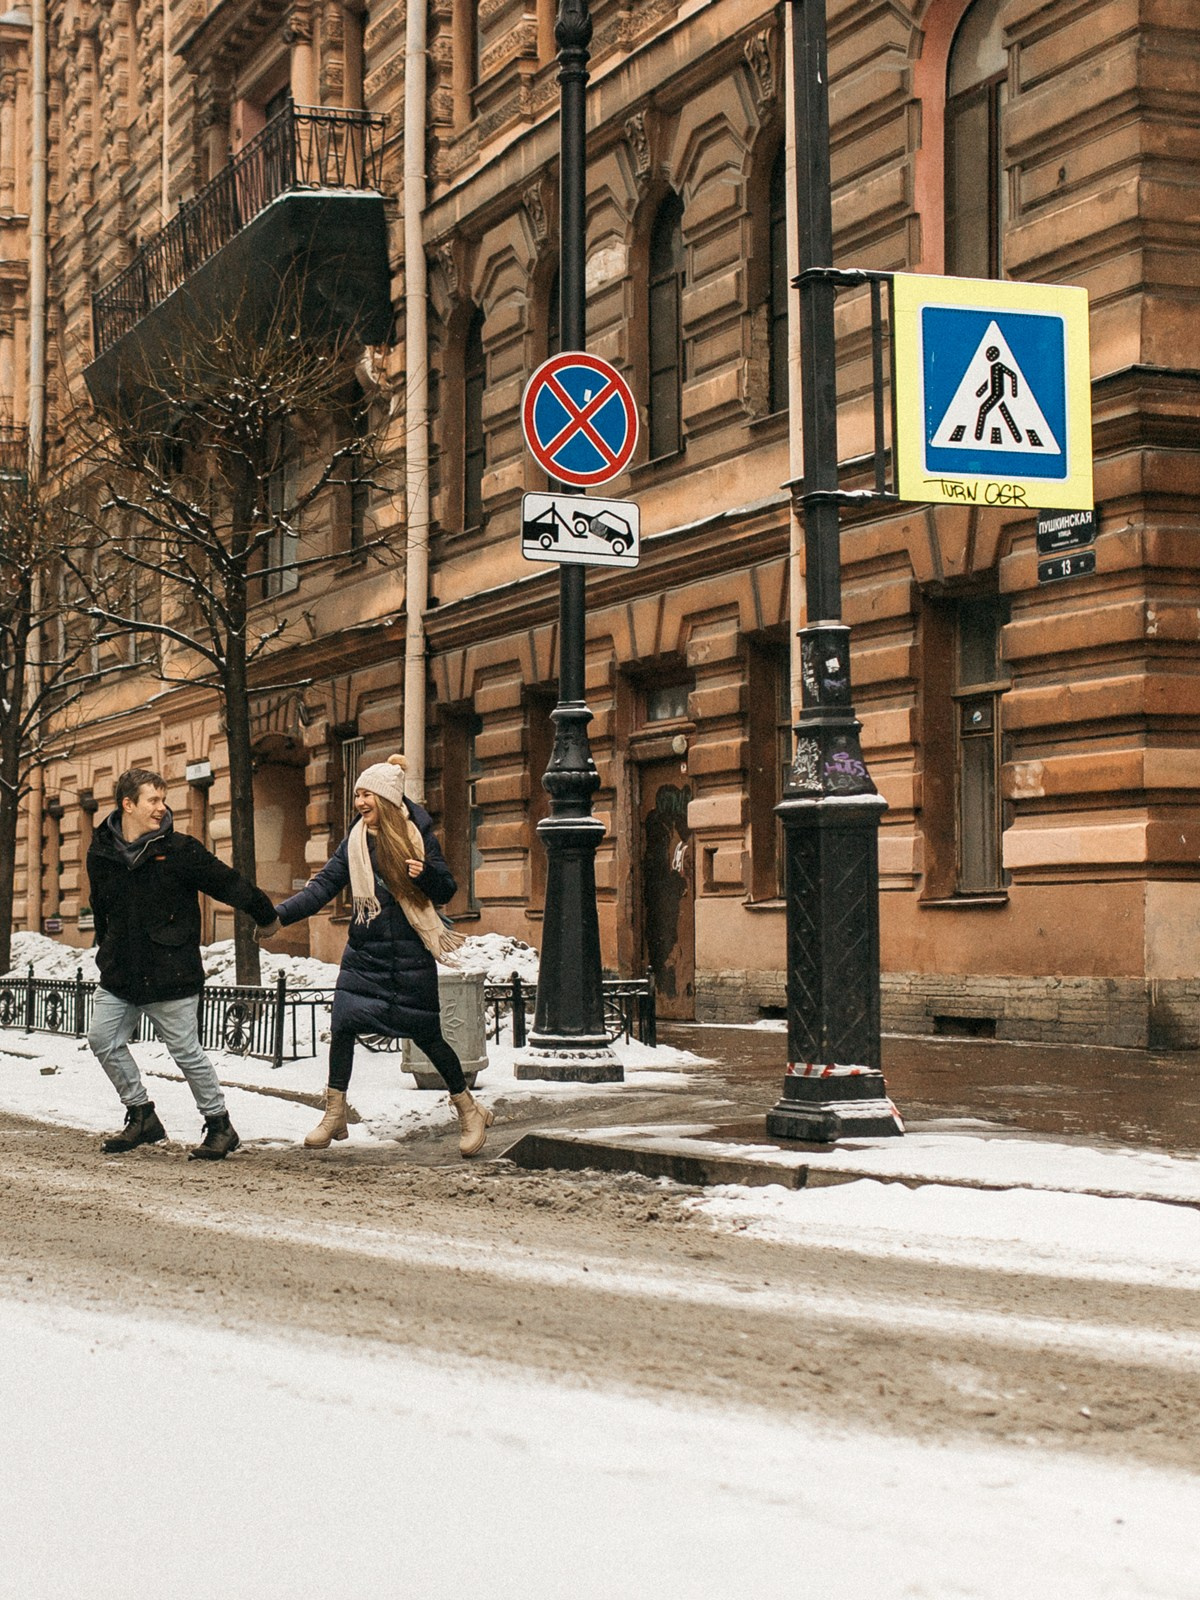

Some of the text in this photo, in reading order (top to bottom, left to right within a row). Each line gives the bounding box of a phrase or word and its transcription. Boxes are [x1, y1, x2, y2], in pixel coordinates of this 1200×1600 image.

[923, 479, 978, 501] TURN
[1039, 511, 1092, 534] ПУШКИНСКАЯ
[1061, 559, 1072, 575] 13
